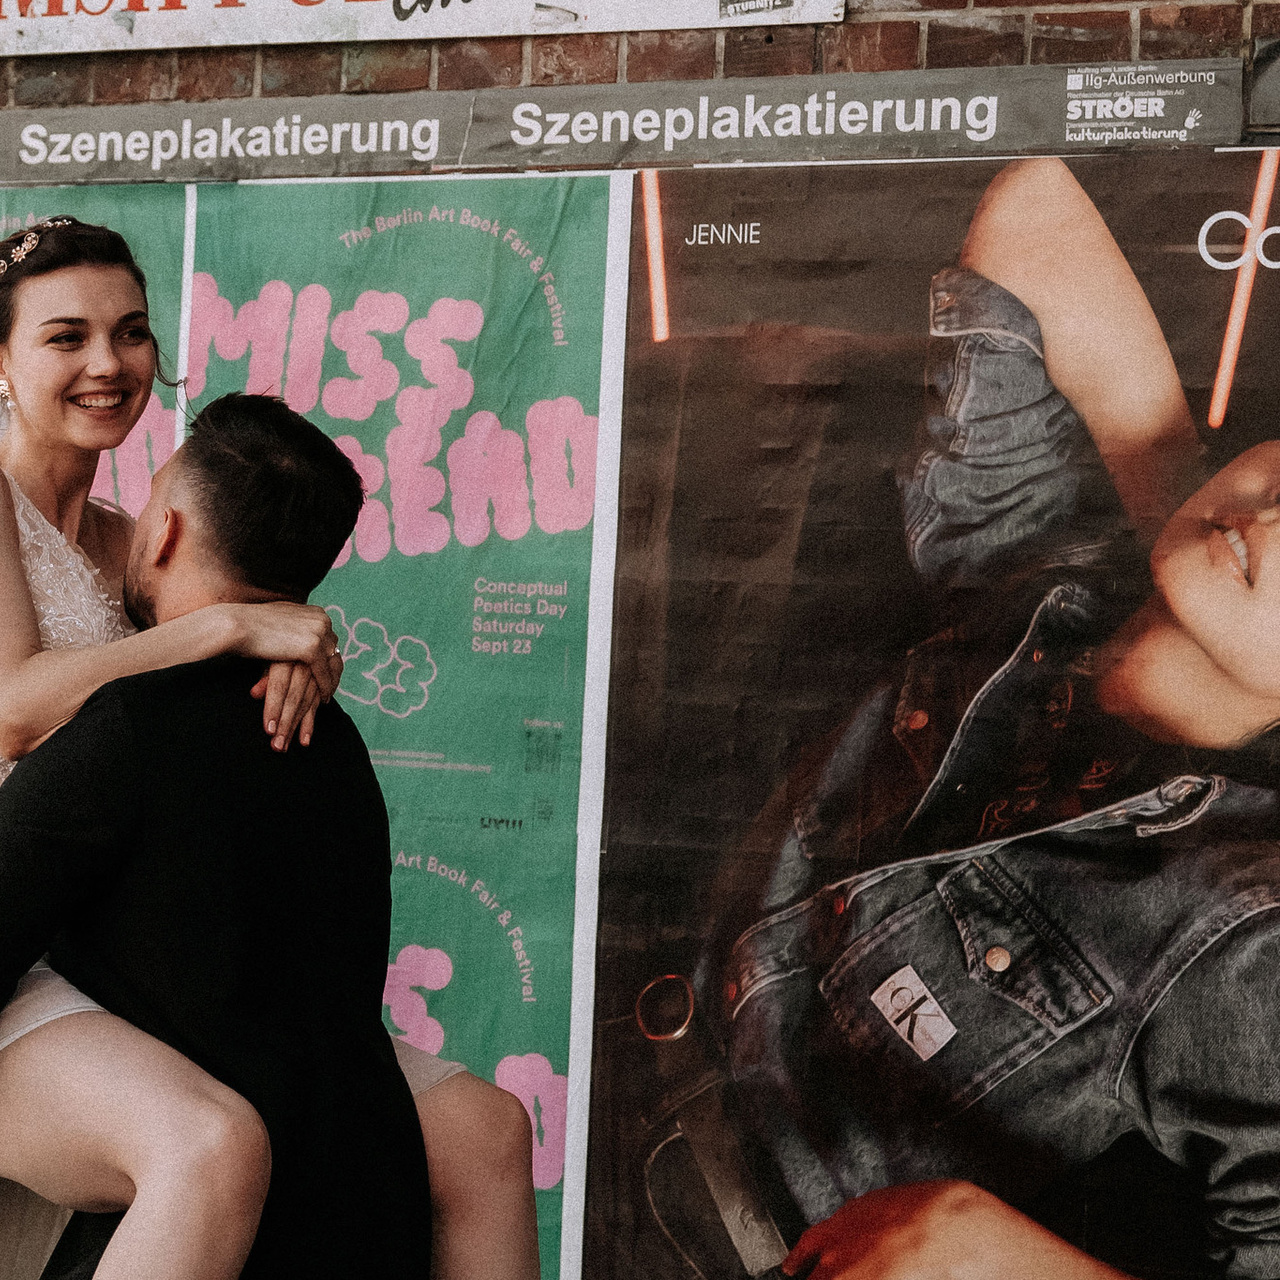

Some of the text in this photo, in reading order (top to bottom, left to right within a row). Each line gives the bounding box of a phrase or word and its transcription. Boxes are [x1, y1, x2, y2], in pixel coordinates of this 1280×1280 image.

[1066, 95, 1166, 121] STRÖER
[511, 91, 1000, 152] Szeneplakatierung
[19, 114, 441, 170] Szeneplakatierung
[1065, 126, 1188, 145] kulturplakatierung
[684, 221, 762, 247] JENNIE
[339, 205, 569, 348] The Berlin Art Book Fair & Festival
[185, 270, 485, 423] MISS
[321, 384, 600, 570] EAD
[474, 576, 568, 598] Conceptual
[473, 596, 568, 619] Poetics Day
[472, 616, 546, 638] Saturday
[471, 637, 533, 656] Sept 23
[394, 850, 422, 870] Art
[426, 856, 468, 888] Book
[470, 879, 500, 911] Fair
[507, 926, 537, 1003] Festival
